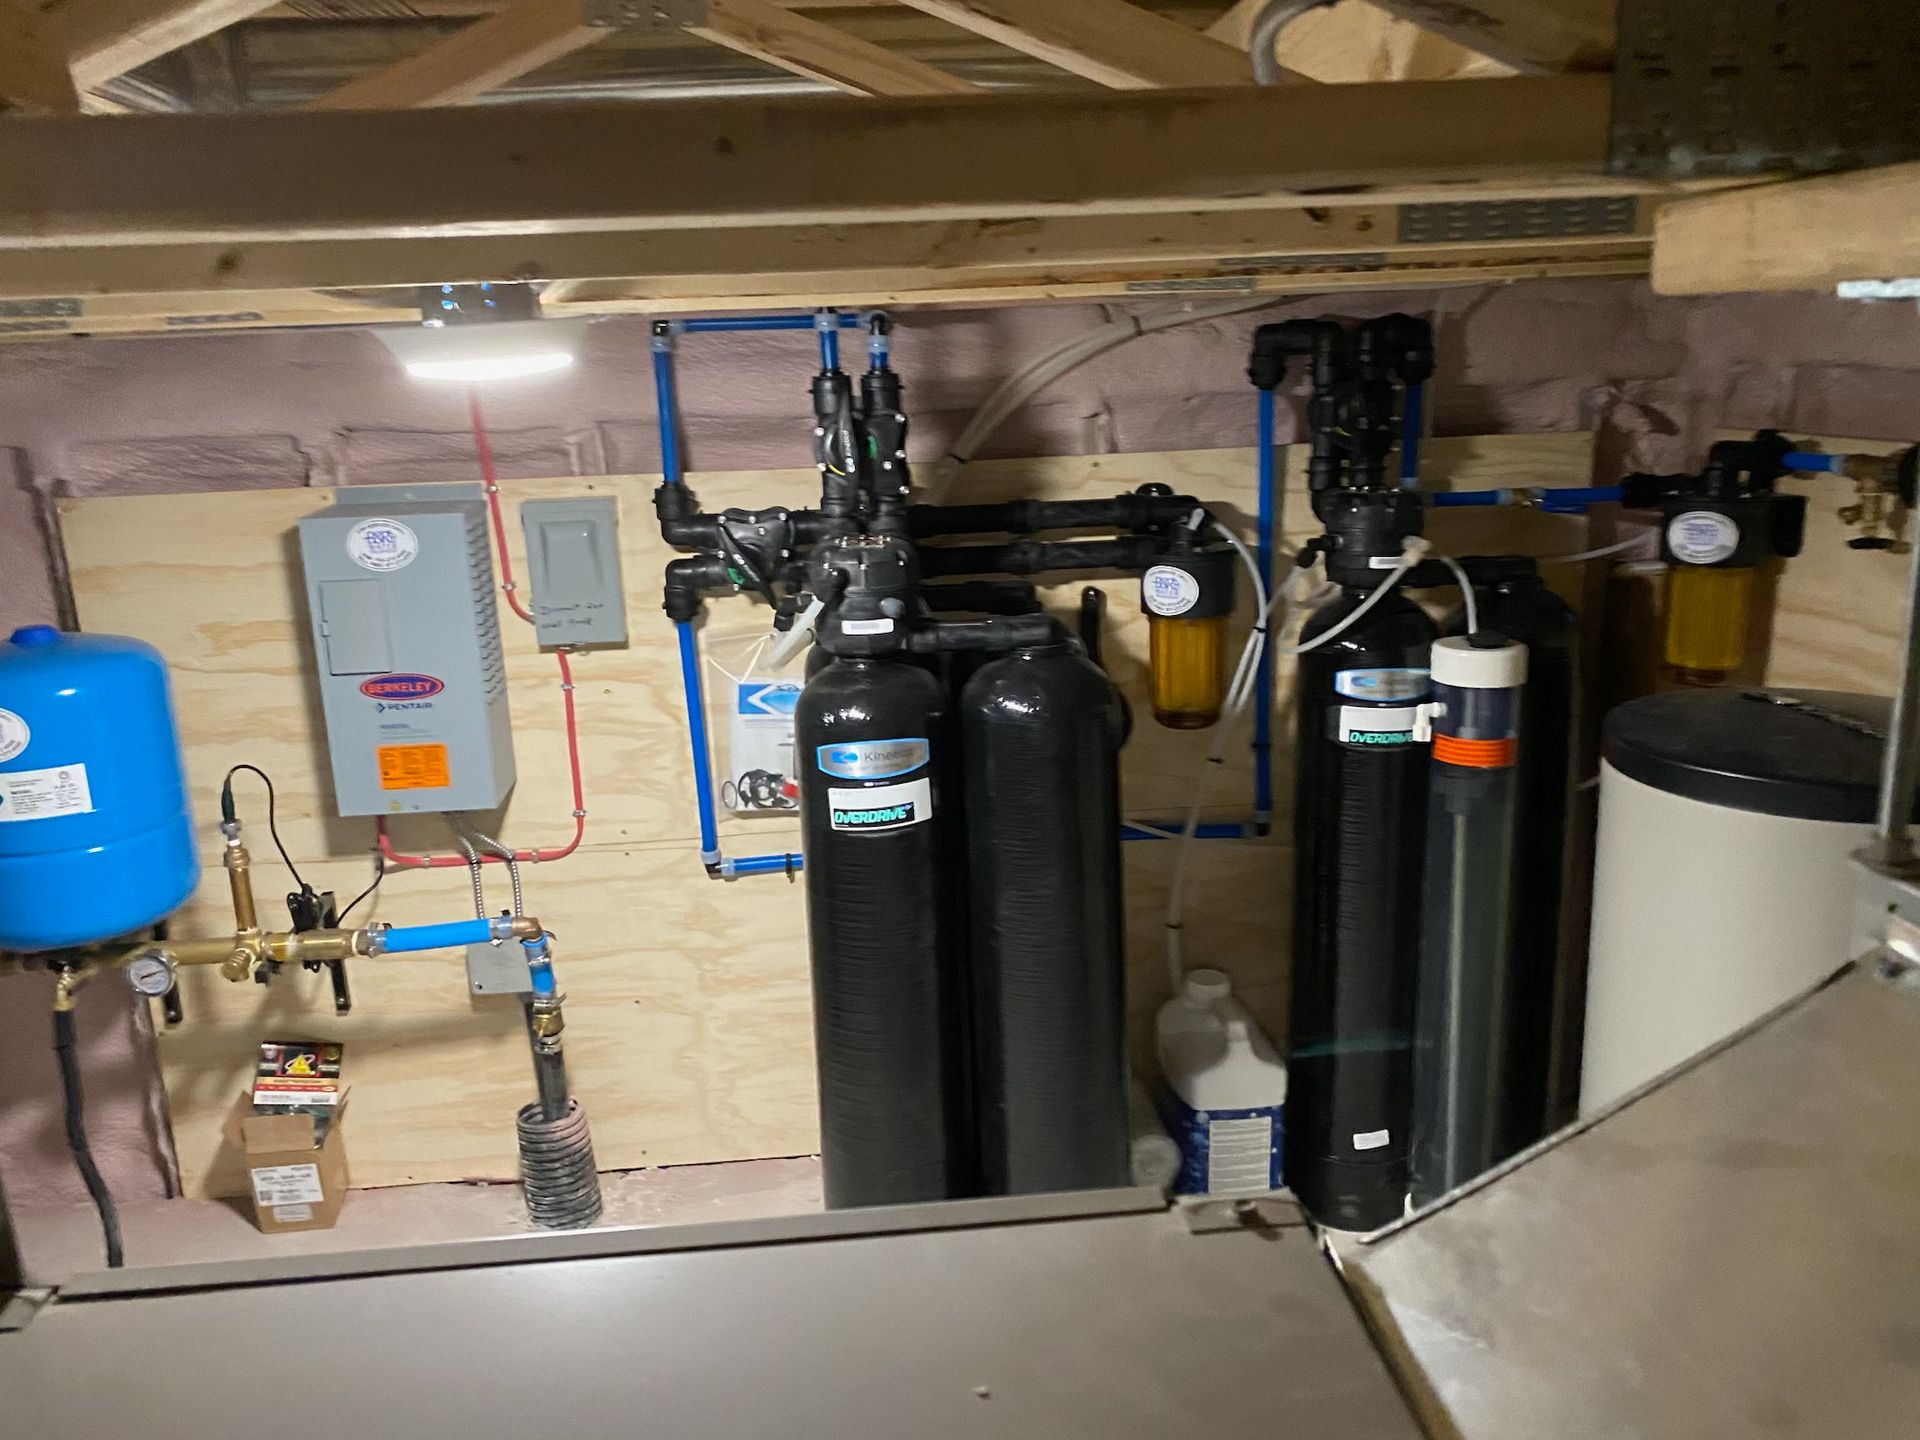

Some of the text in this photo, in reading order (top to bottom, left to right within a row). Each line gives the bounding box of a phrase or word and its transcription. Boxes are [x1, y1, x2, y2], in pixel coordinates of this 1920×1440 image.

[366, 682, 432, 694] BERKELEY
[388, 702, 432, 711] PENTAIR
[864, 749, 916, 761] Kinet
[834, 807, 907, 824] OVERDRIVE
